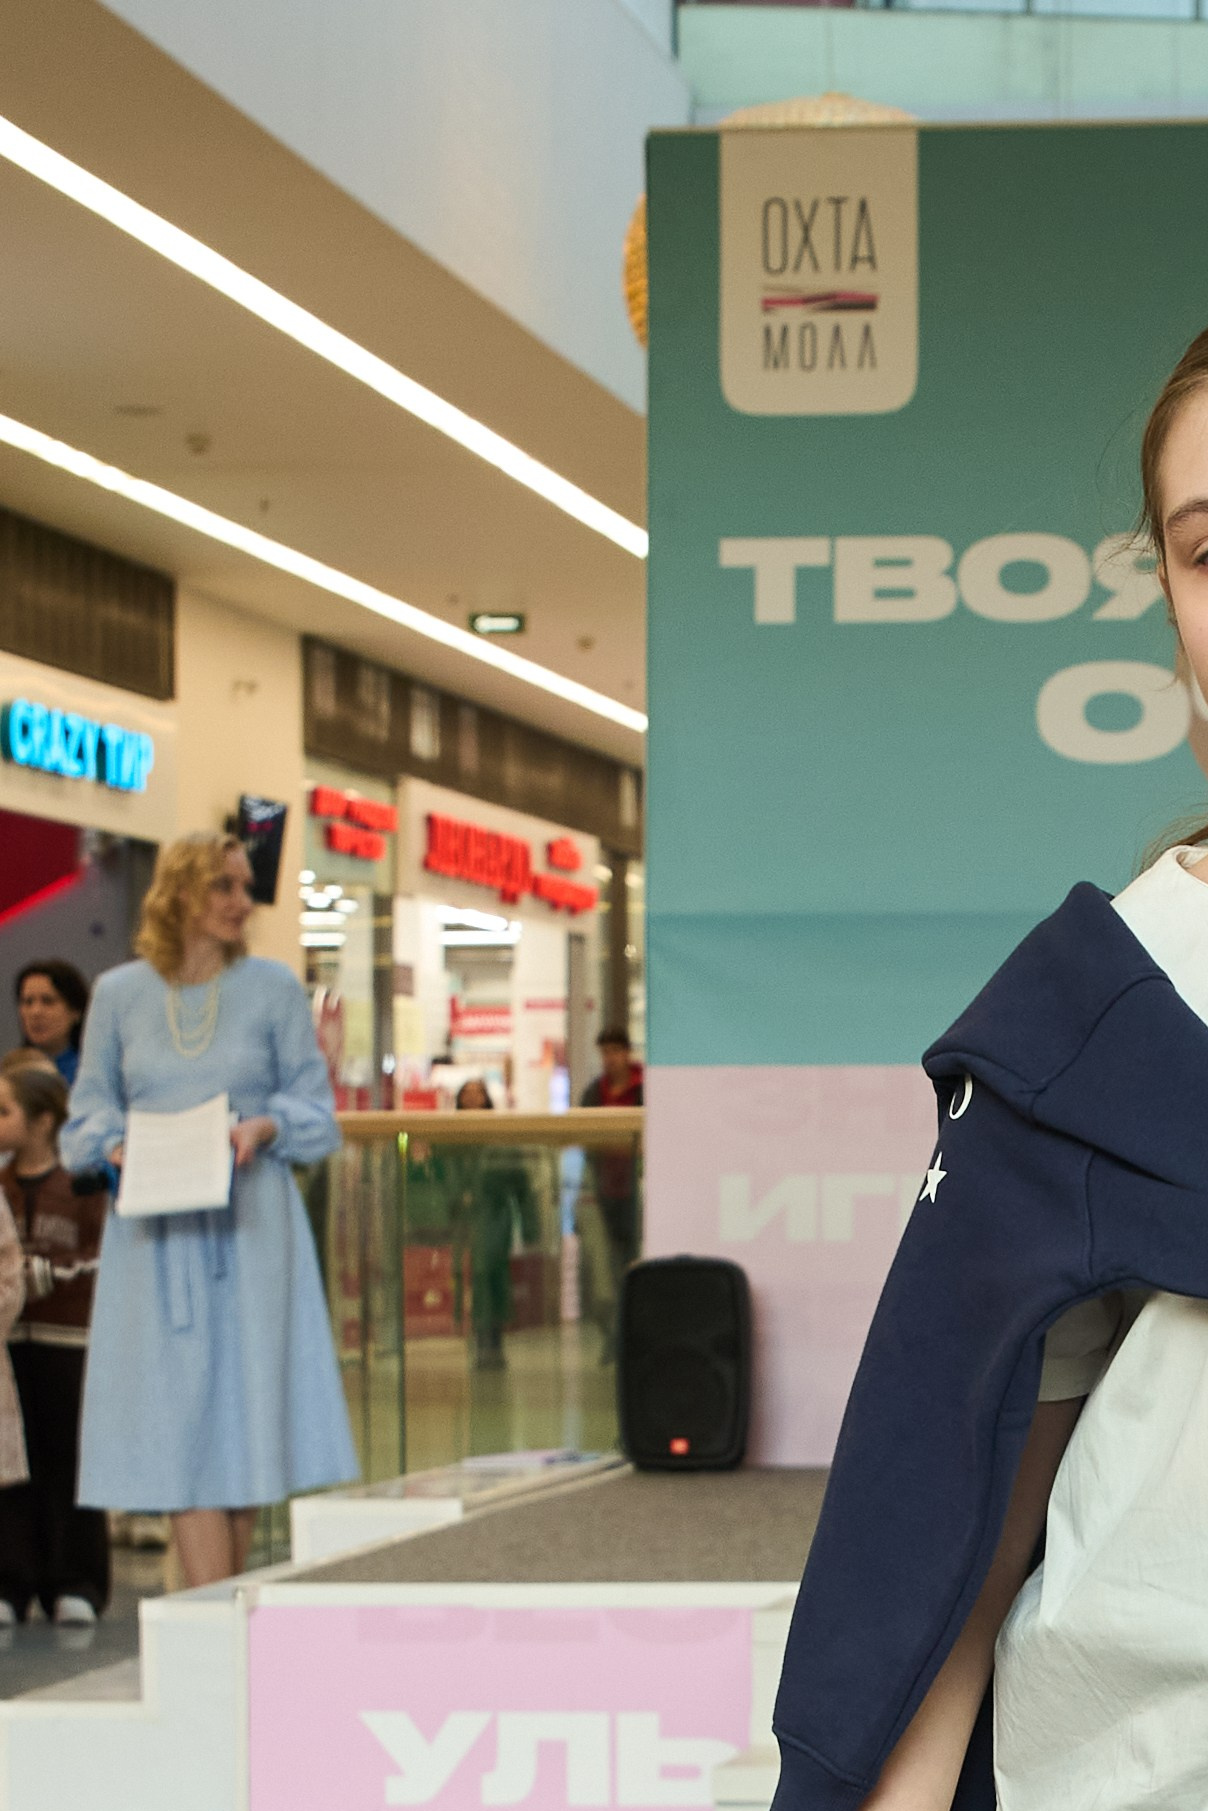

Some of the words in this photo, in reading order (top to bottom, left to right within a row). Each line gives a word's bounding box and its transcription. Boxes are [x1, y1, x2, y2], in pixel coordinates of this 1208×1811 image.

[761, 196, 879, 276] ОХТА
[762, 322, 878, 372] МОЛЛ
[9, 697, 101, 782] CRAZY
